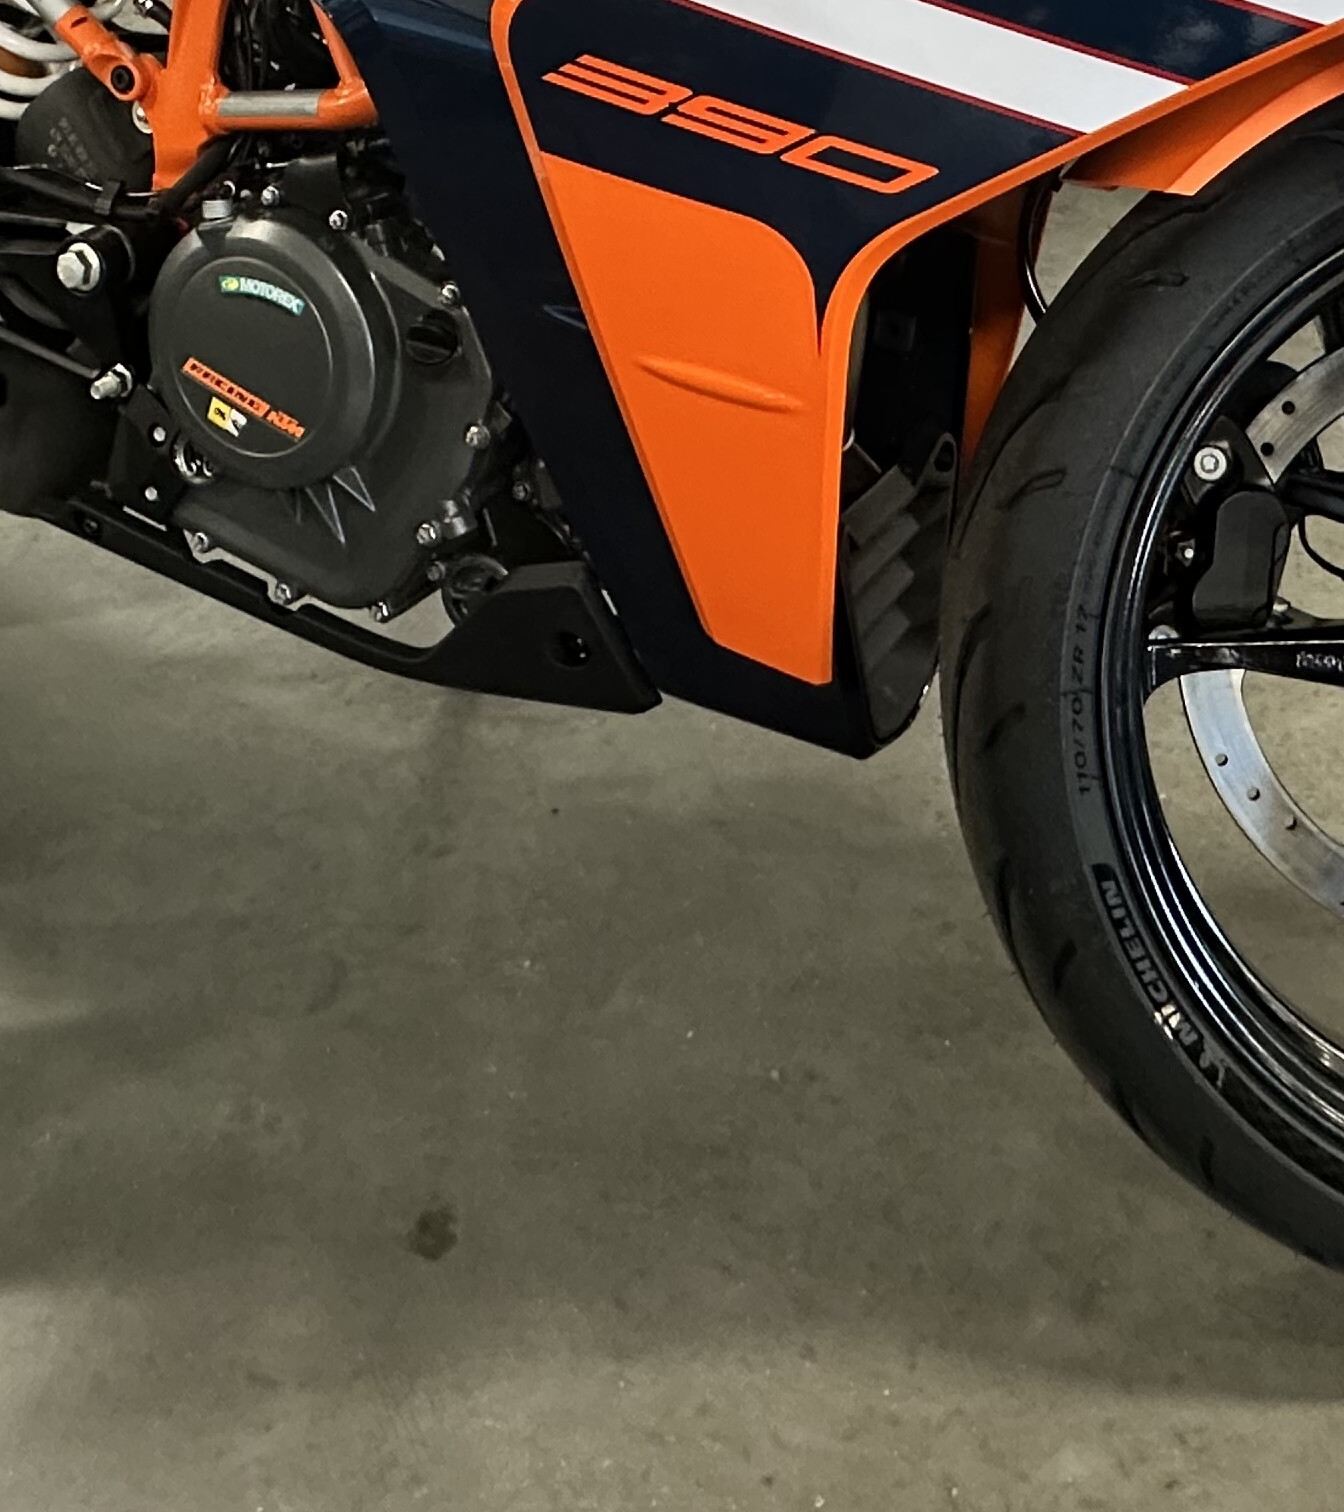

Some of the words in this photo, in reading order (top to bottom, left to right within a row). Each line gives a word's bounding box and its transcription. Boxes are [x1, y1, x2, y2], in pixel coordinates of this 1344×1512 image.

[541, 53, 940, 194] 390
[266, 408, 306, 439] KTM
[1100, 879, 1199, 1046] MICHELIN
